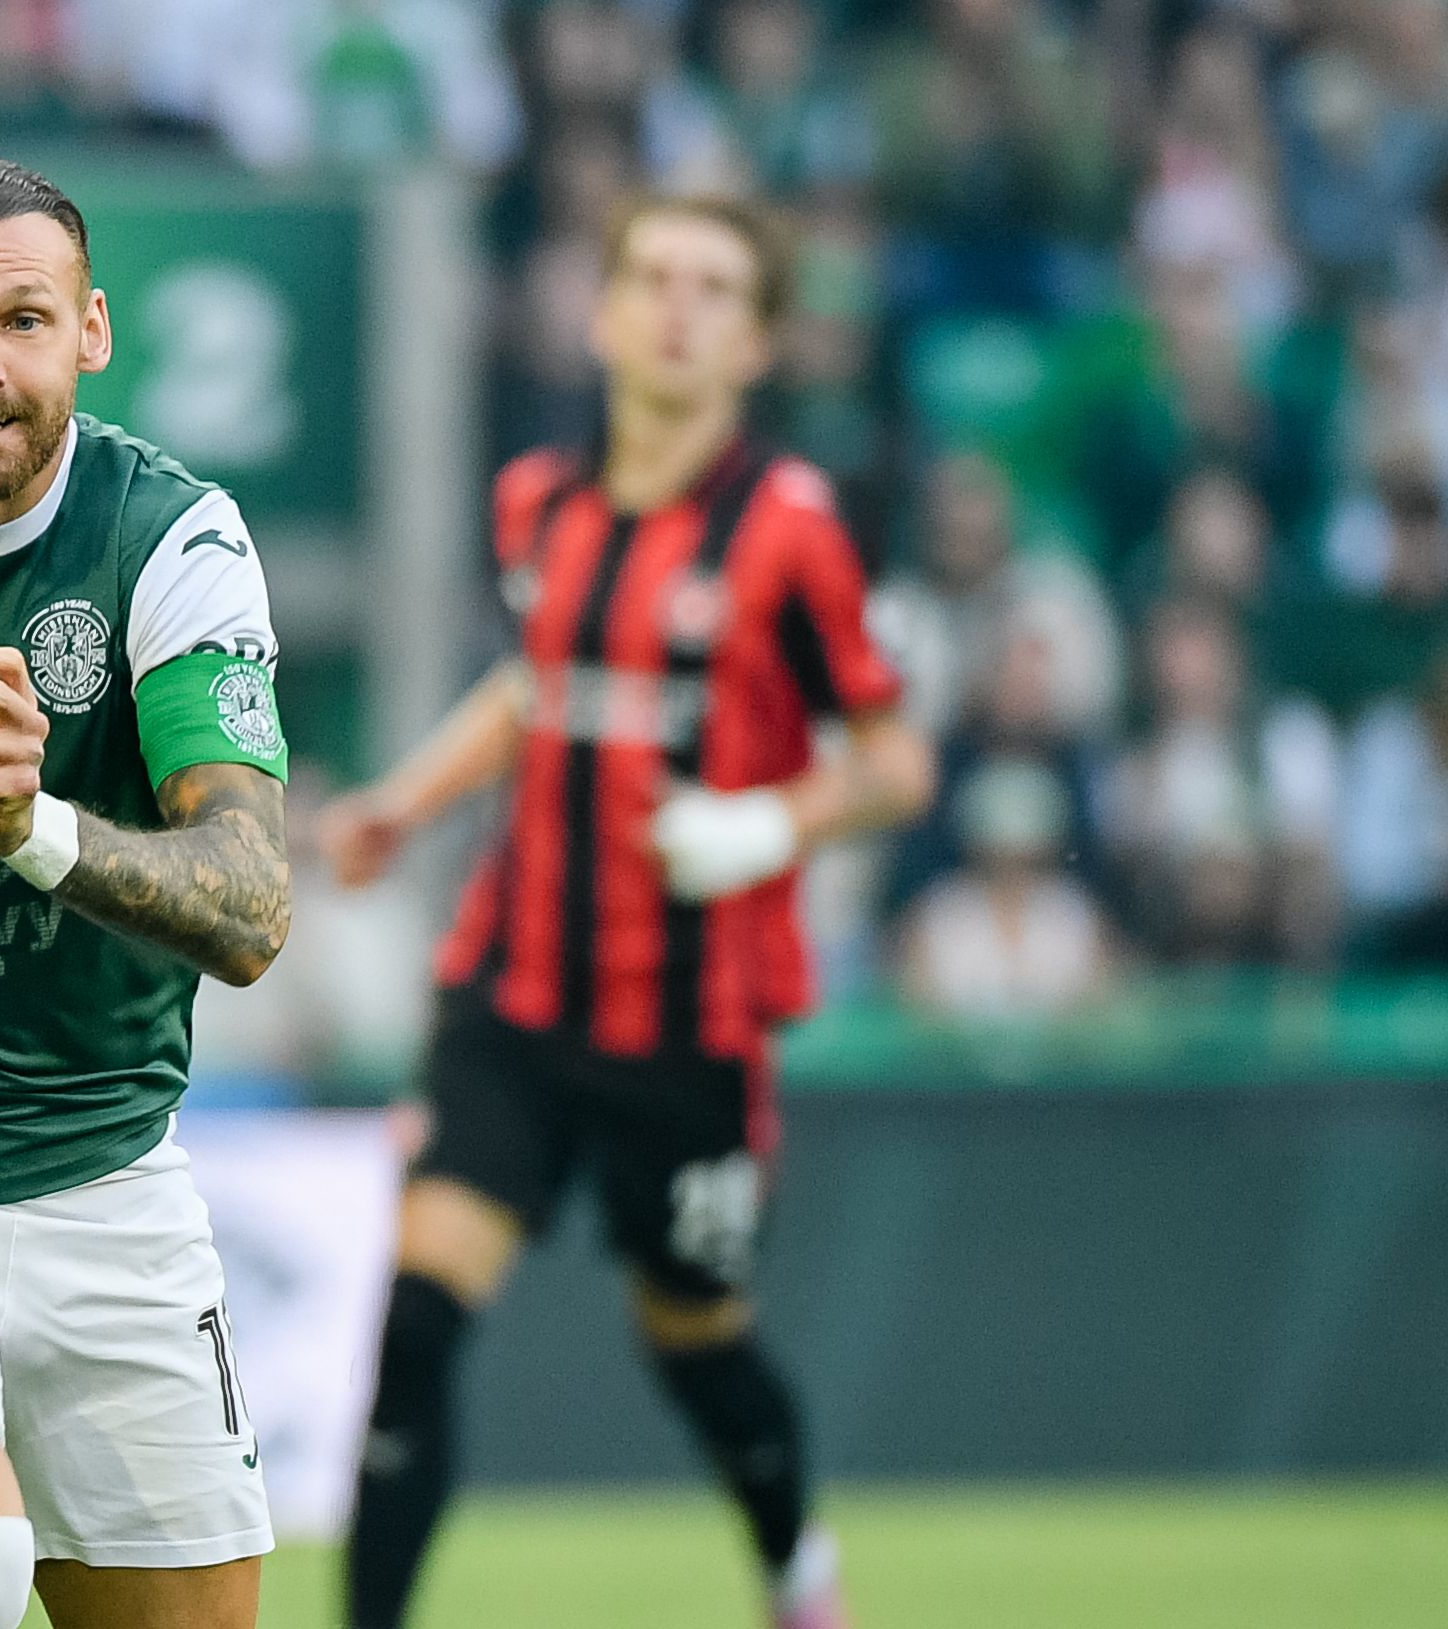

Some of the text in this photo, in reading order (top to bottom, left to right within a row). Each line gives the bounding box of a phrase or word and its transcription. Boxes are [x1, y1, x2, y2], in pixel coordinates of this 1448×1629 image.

[144, 266, 296, 462] 2
[37, 614, 100, 641] HIBERNIAN
[41, 674, 98, 698] EDINBURGH
